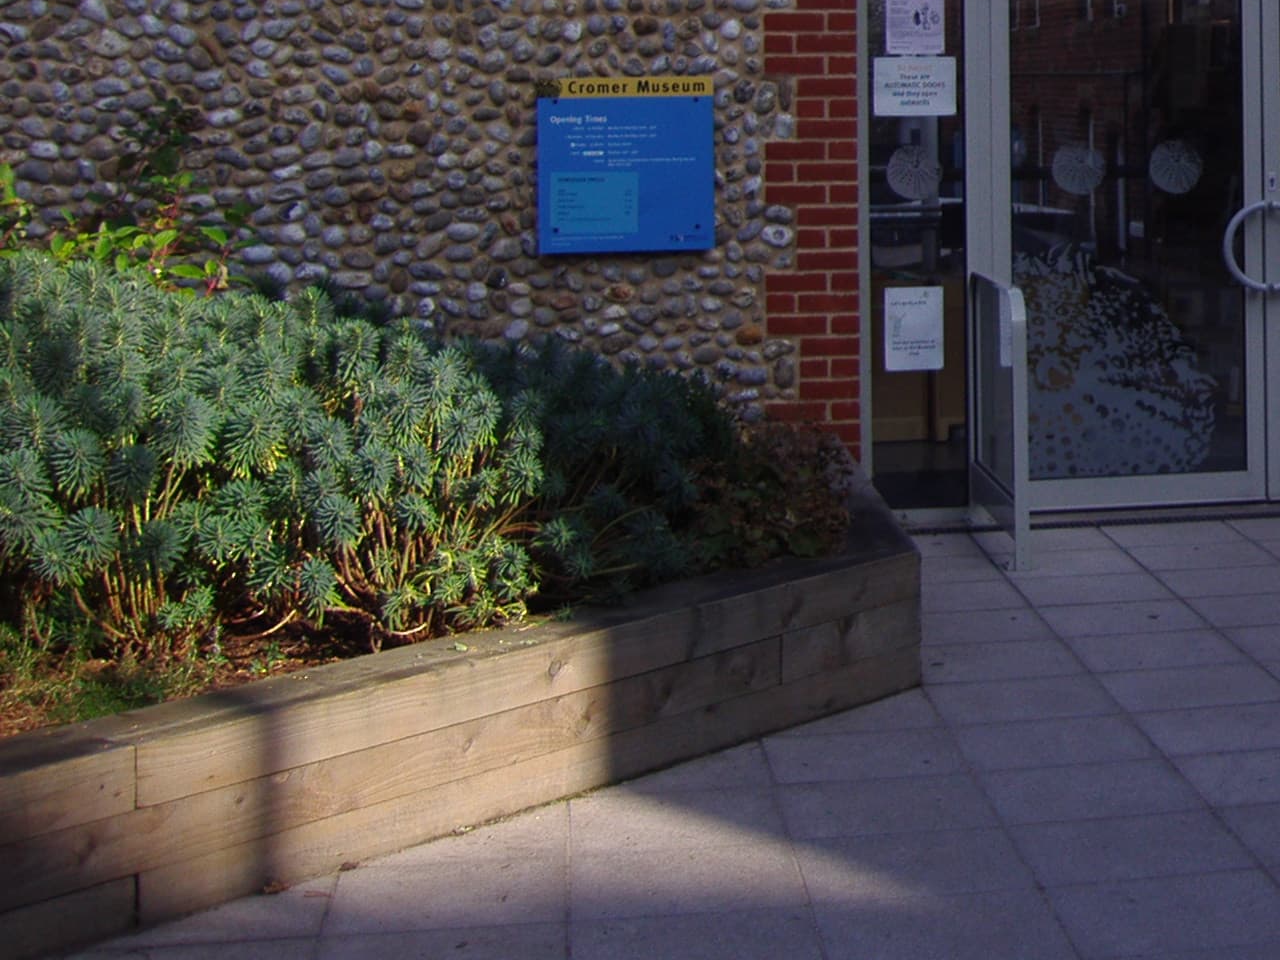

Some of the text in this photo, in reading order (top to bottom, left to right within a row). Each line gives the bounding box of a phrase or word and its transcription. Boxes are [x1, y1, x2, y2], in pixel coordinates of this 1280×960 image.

[568, 81, 705, 94] Cromer Museum
[550, 115, 608, 125] Opening Times
